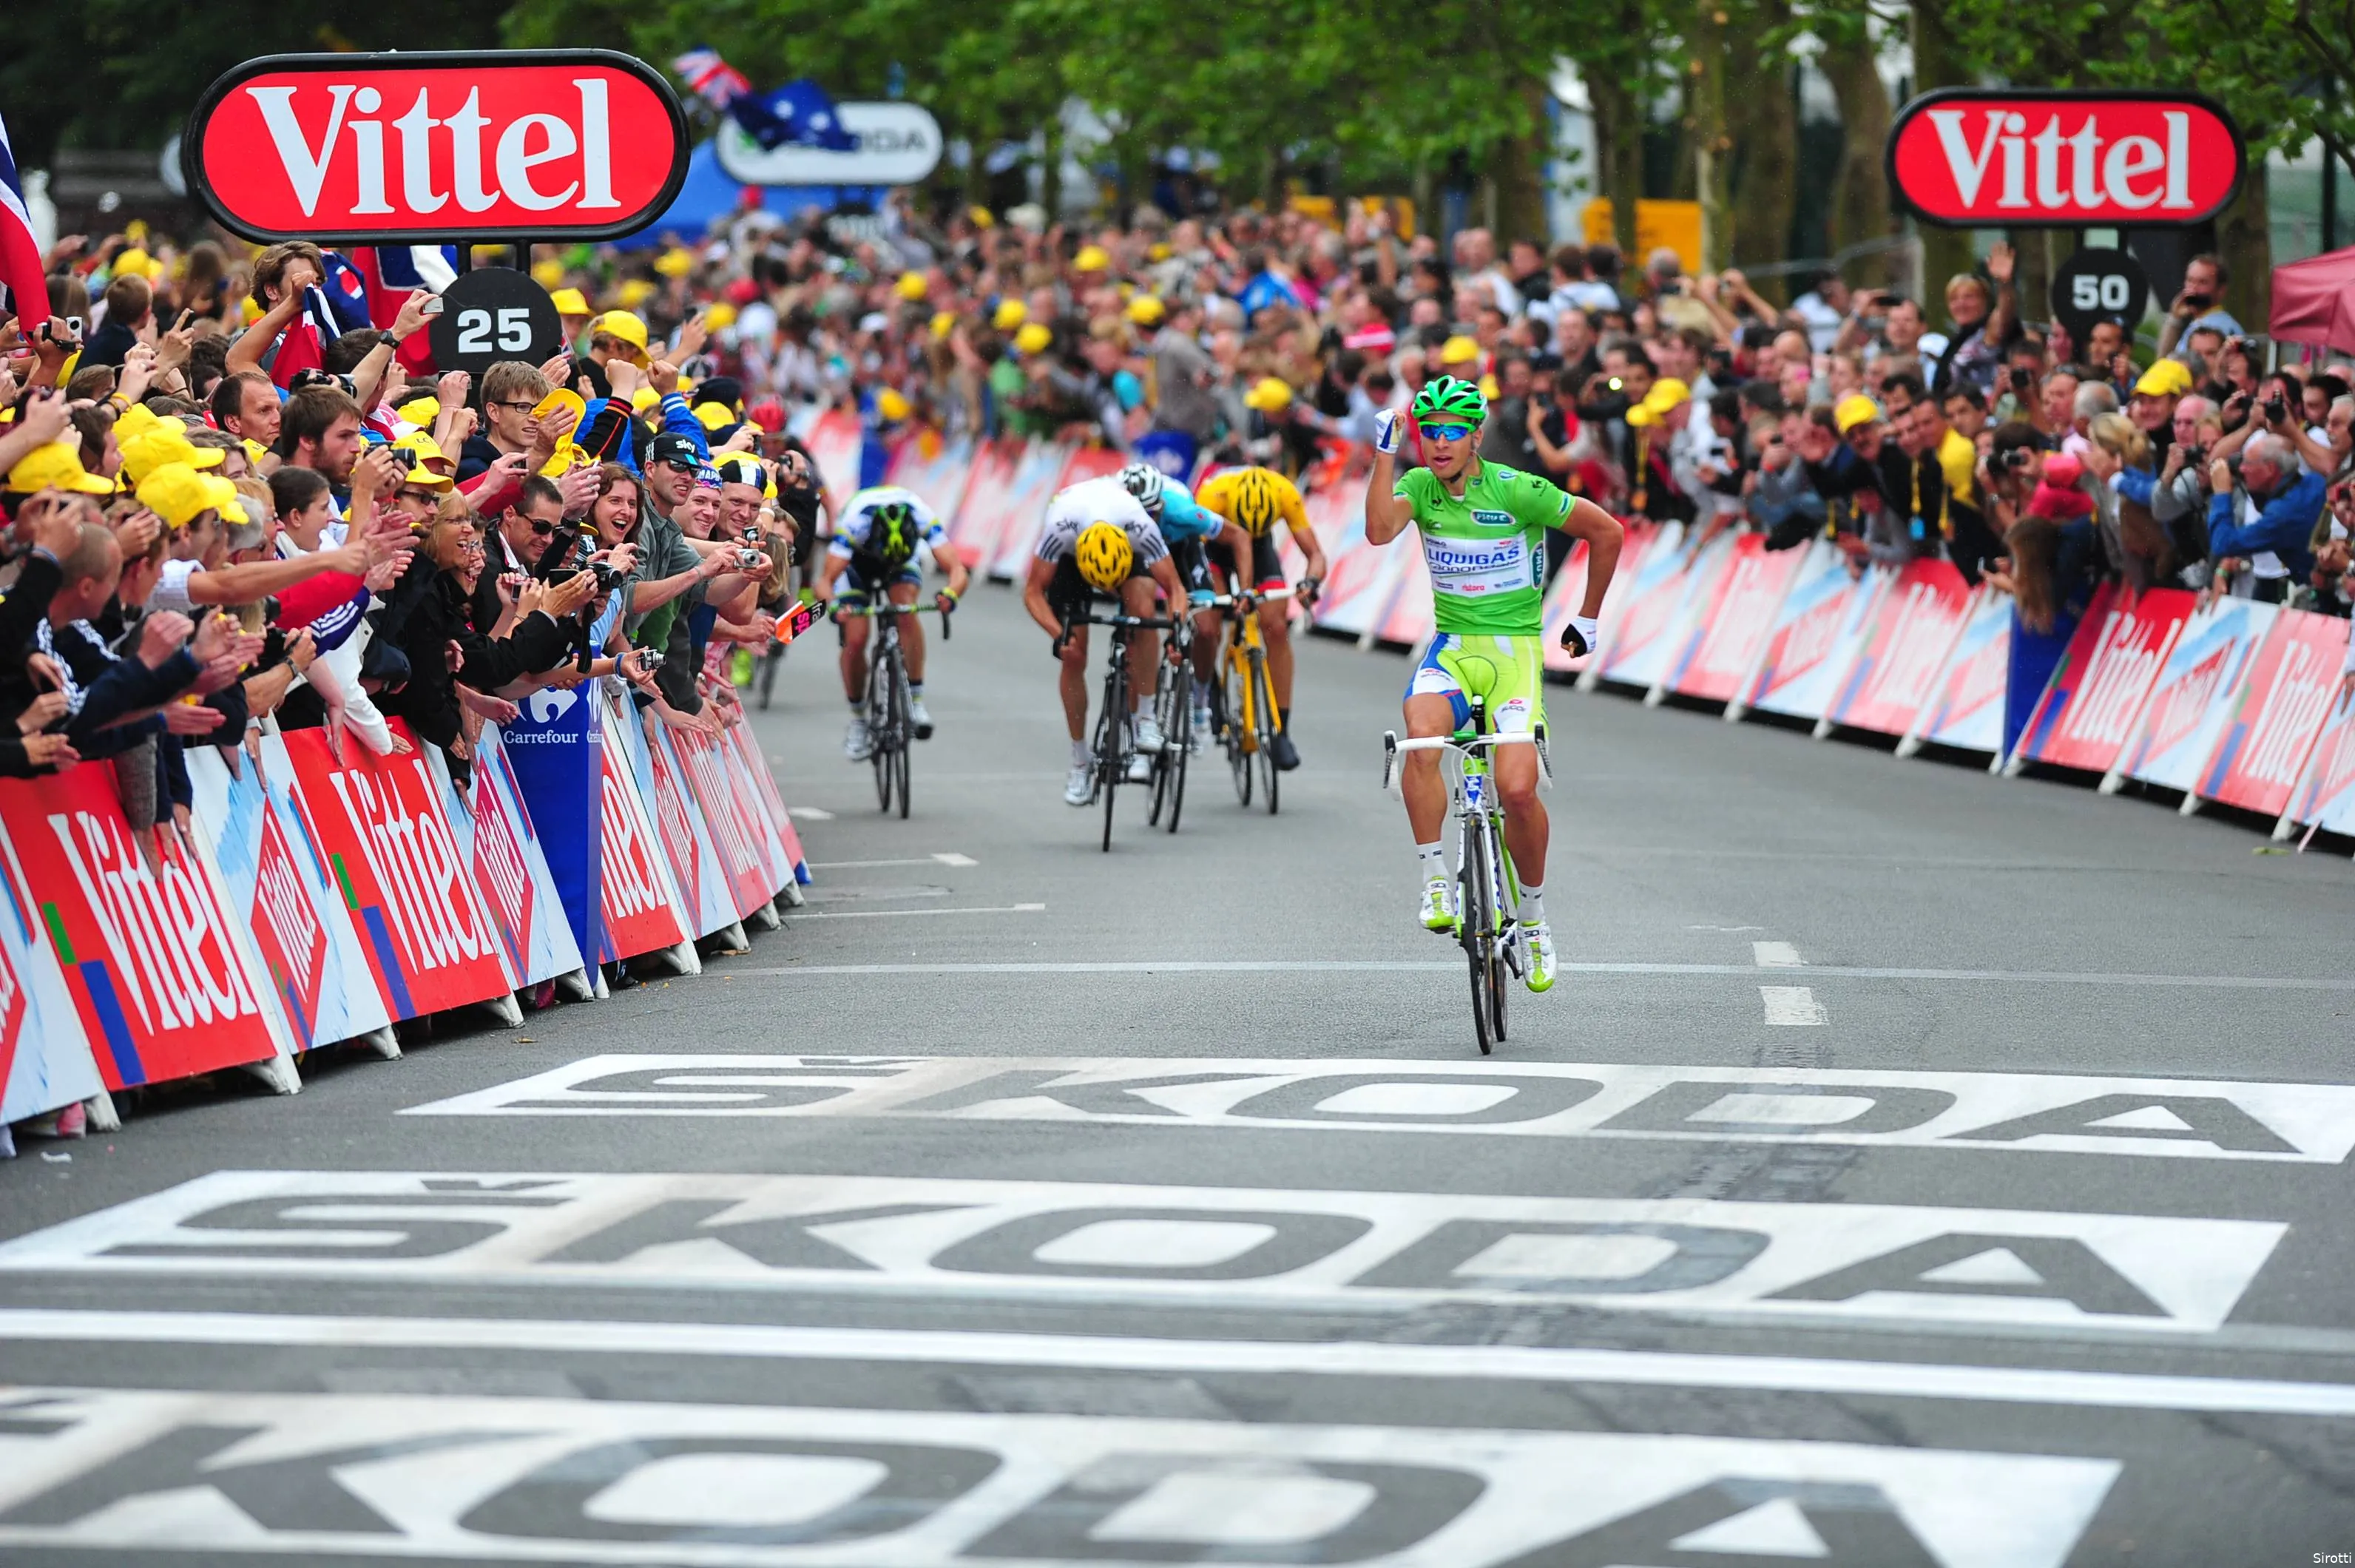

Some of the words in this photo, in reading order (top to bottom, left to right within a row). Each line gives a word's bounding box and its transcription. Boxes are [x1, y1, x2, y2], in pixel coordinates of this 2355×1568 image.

[246, 78, 622, 217] Vittel
[1927, 110, 2194, 210] Vittel
[457, 307, 533, 354] 25
[2072, 274, 2130, 311] 50
[675, 439, 696, 453] sky
[1428, 546, 1520, 565] LIQUIGAS
[503, 729, 578, 744] Carrefour
[258, 811, 317, 1004] Vittel
[328, 759, 494, 976] Vittel
[47, 811, 258, 1036] Vittel
[497, 1057, 2305, 1154] ŠKODA
[87, 1180, 2179, 1318] ŠKODA
